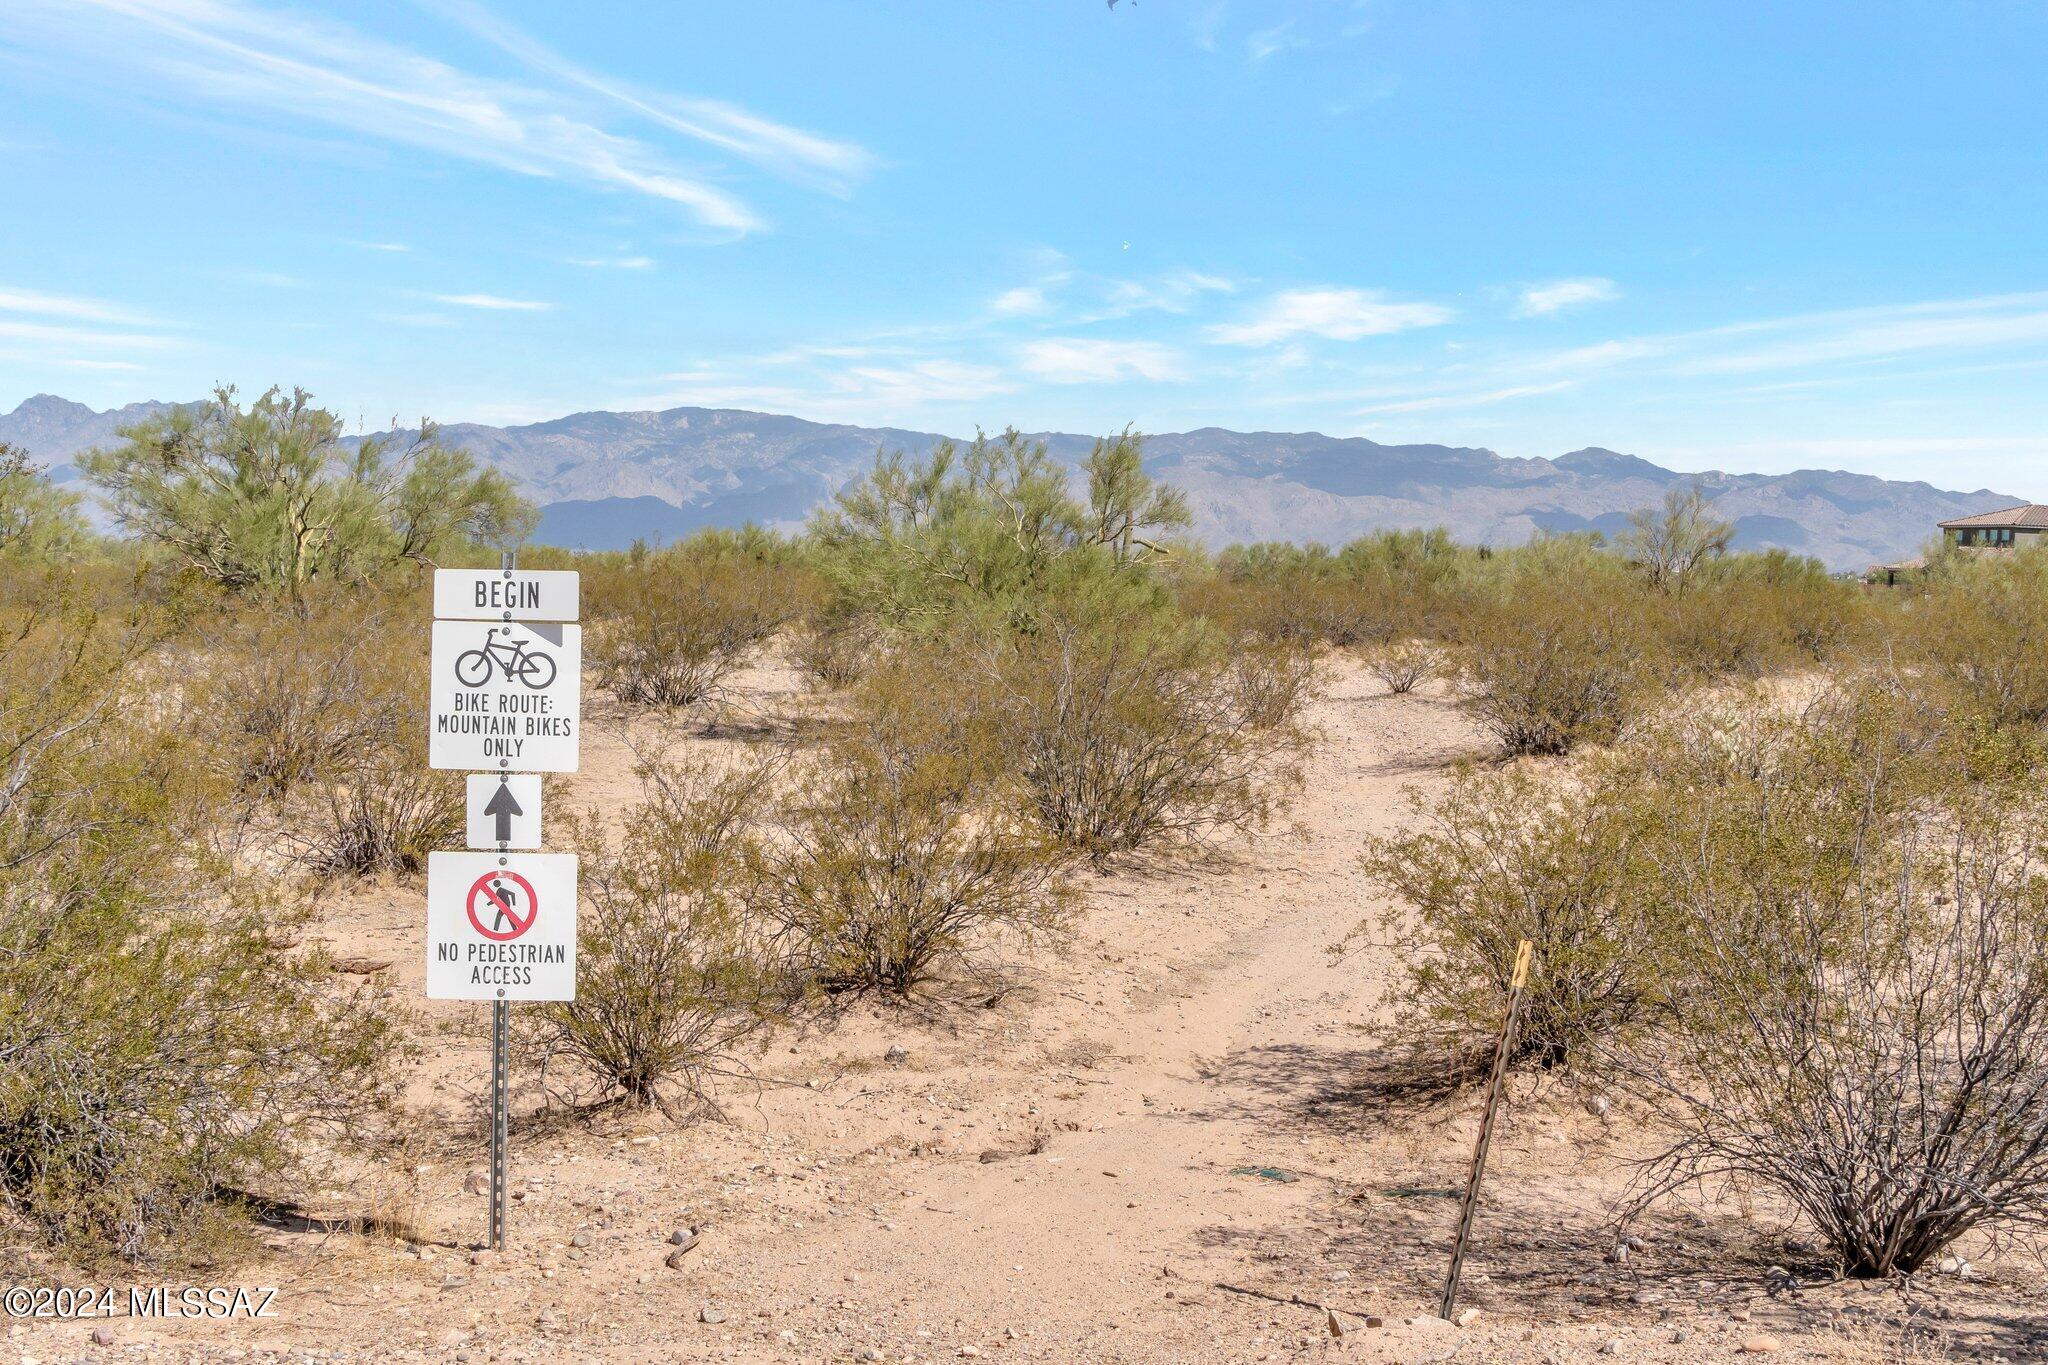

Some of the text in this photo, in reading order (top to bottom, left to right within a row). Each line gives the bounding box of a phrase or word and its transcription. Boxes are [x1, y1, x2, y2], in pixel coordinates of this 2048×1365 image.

[475, 580, 540, 609] BEGIN
[454, 693, 553, 714] BIKE ROUTE:
[438, 714, 571, 736] MOUNTAIN BIKES
[484, 738, 524, 757] ONLY
[438, 942, 565, 963] NO PEDESTRIAN
[471, 965, 532, 985] ACCESS
